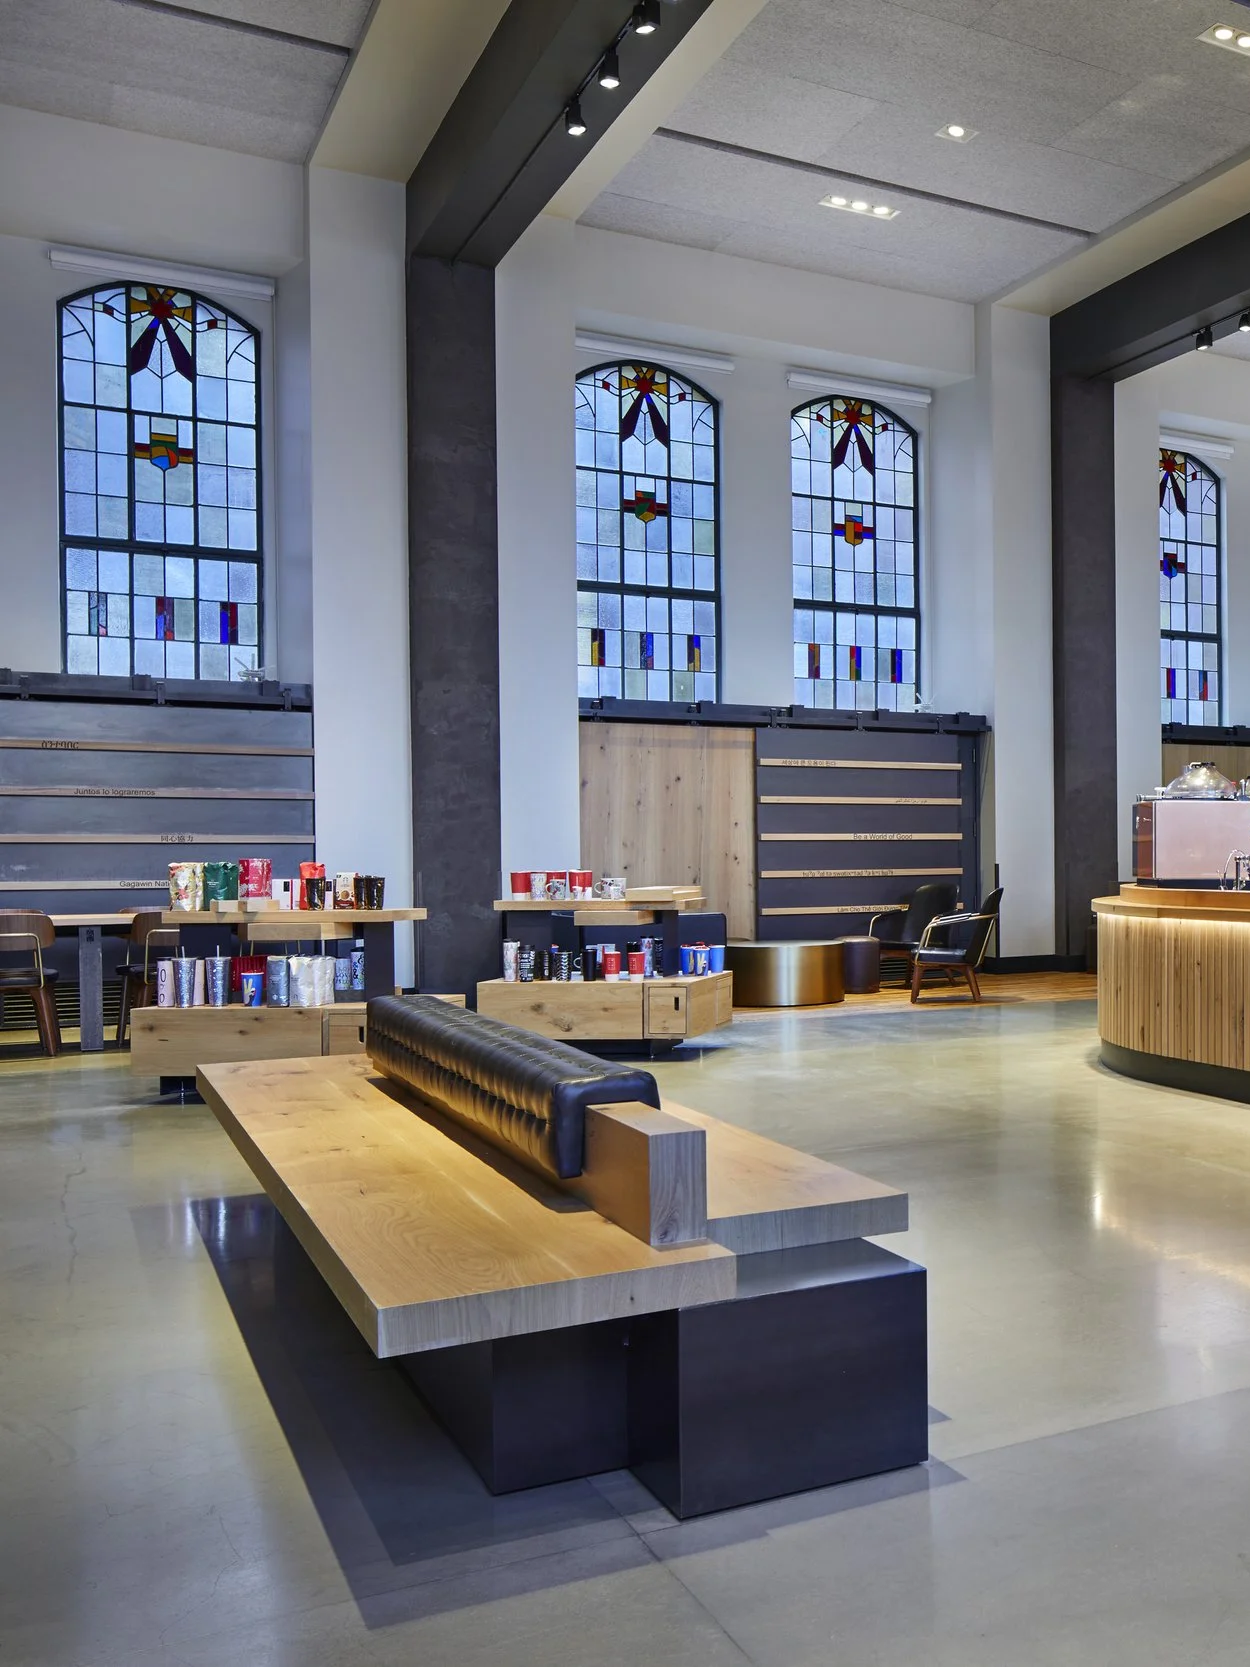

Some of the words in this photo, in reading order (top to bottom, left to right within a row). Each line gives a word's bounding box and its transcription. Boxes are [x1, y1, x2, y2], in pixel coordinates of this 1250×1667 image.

[74, 788, 100, 796] Juntos
[102, 788, 110, 796] lo
[111, 789, 156, 797] lograremos
[119, 880, 153, 889] Gagawin
[154, 880, 170, 888] Nati
